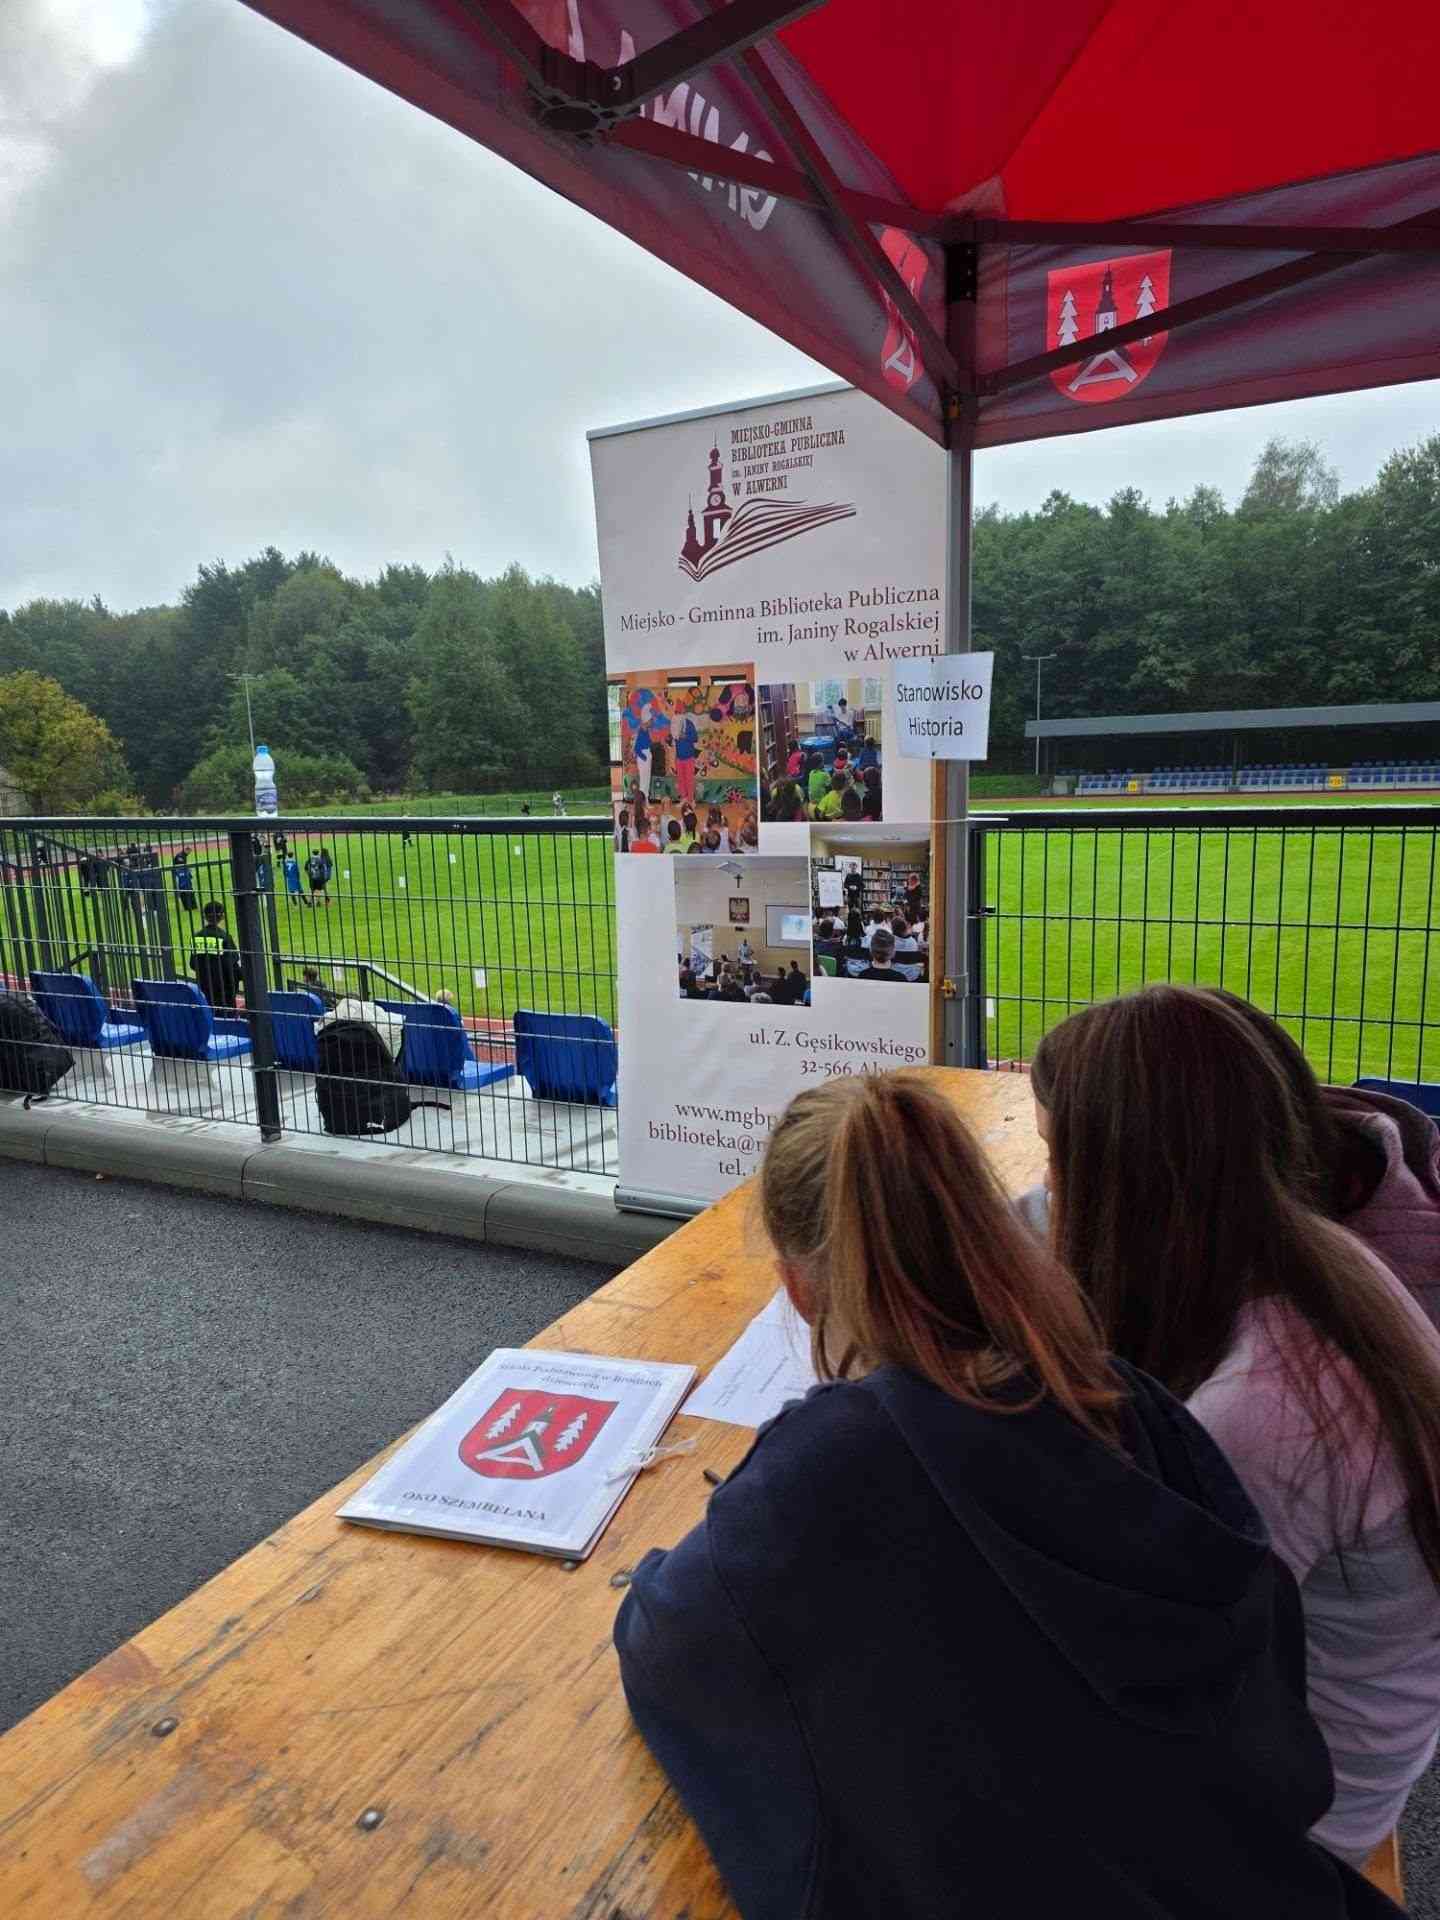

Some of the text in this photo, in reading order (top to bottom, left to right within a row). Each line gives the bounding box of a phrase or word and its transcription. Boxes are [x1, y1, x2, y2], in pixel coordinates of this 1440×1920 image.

[731, 416, 813, 443] MIEJSKO-GMINNA
[731, 430, 845, 462] BIBLIOTEKA PUBLICZNA
[744, 462, 769, 478] JANINY
[732, 475, 788, 496] W ALWERNI
[620, 610, 675, 632] Miejsko
[688, 605, 755, 624] Gminna
[760, 592, 843, 617] Biblioteka
[848, 586, 940, 608] Publiczna
[757, 610, 939, 647] im. Janiny Rogalskiej
[844, 638, 940, 662] w Alwerni
[897, 680, 983, 702] Stanowisko
[908, 716, 964, 736] Historia
[750, 1028, 926, 1062] ul. Z. Gęsikowskiego
[800, 1060, 852, 1077] 32-566
[675, 1104, 777, 1131] www.mgbp
[719, 1158, 746, 1176] tel.
